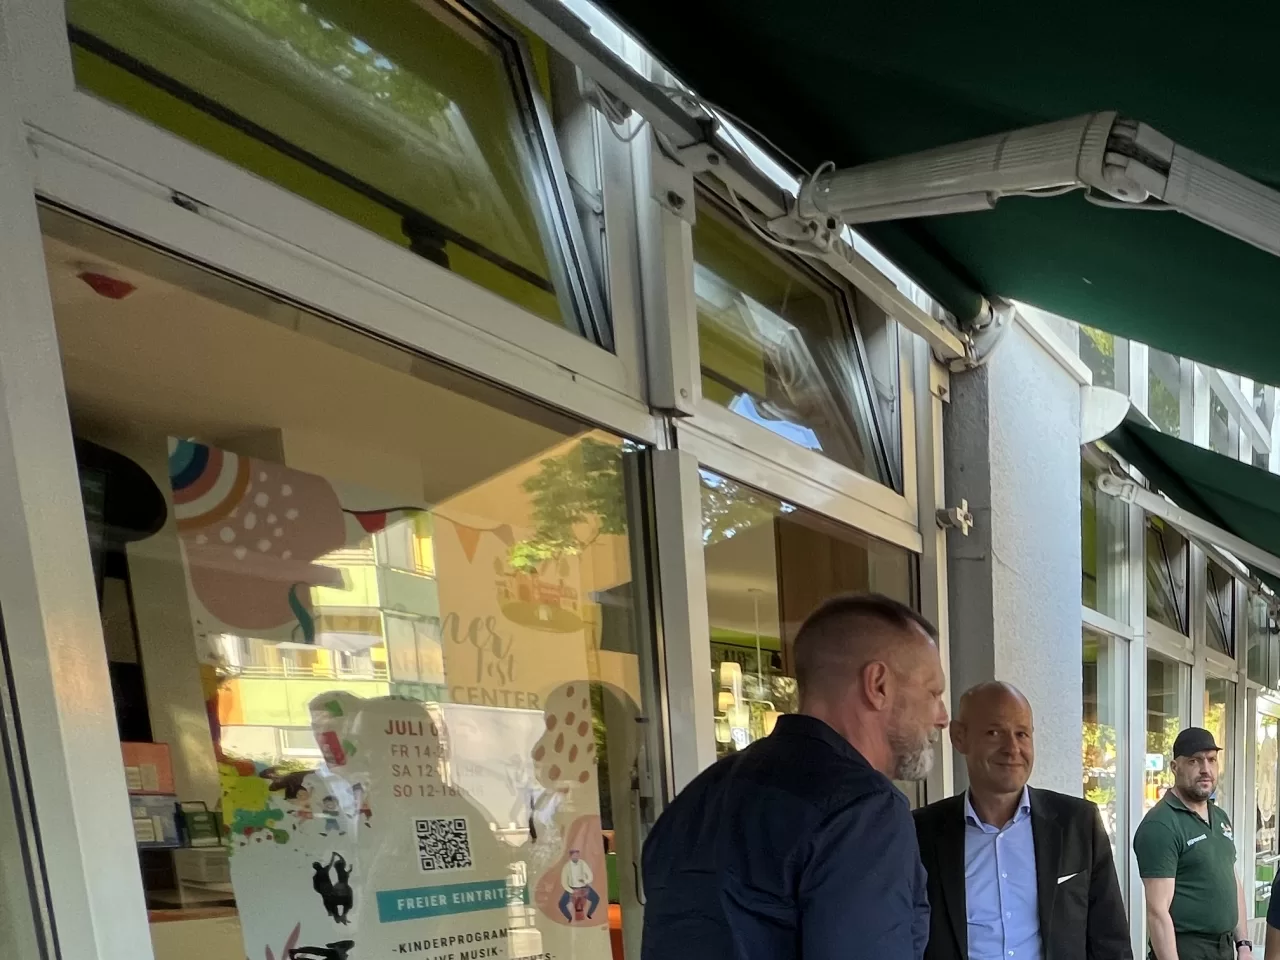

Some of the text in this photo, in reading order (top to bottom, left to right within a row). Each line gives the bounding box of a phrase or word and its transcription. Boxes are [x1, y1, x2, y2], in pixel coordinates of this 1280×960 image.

[451, 685, 540, 709] CENTER
[384, 720, 423, 736] JULI
[391, 744, 409, 758] FR
[392, 764, 412, 778] SA
[393, 784, 412, 798] SO
[397, 887, 512, 911] FREIER EINTRIT
